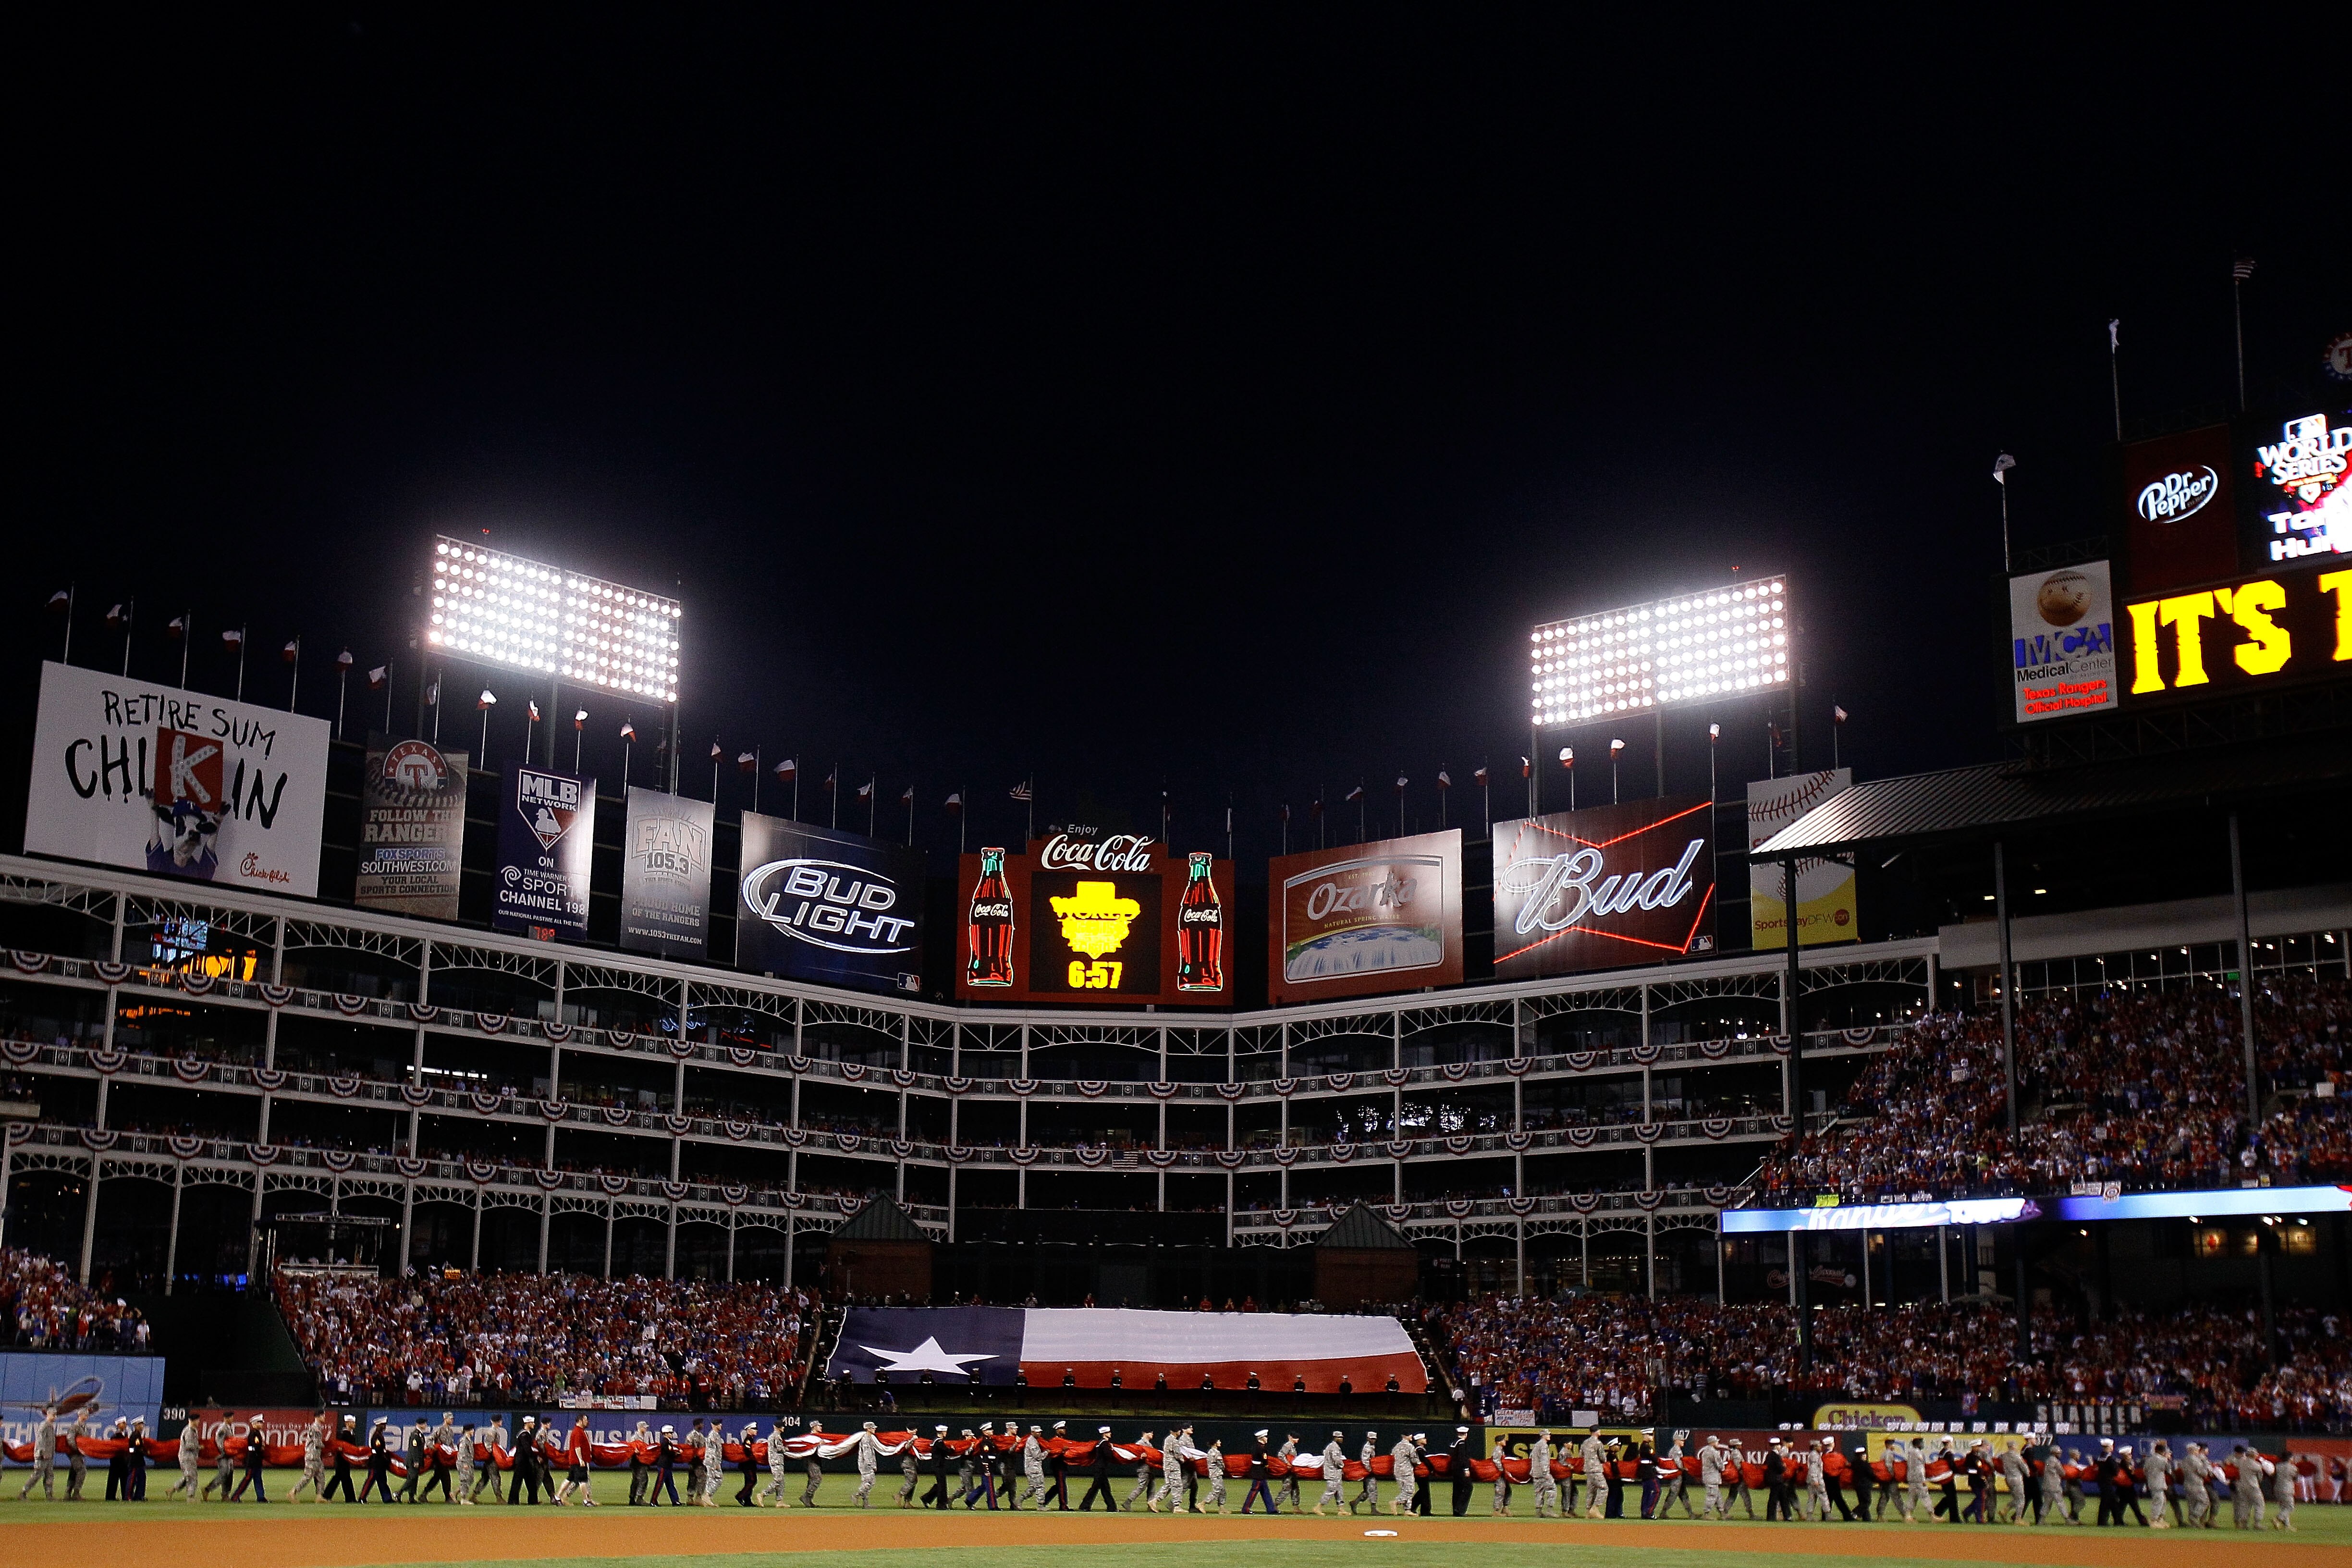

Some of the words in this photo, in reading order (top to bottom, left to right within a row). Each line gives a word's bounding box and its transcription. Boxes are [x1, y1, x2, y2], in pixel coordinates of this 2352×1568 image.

[2256, 427, 2352, 467] WORLD
[2271, 453, 2347, 485] SERIES
[2165, 472, 2193, 497] Dr
[2139, 476, 2212, 521] Pepper
[2015, 623, 2112, 668] MCA
[2127, 580, 2291, 695] IT'S
[2023, 687, 2056, 700] Texas
[2058, 679, 2107, 695] Rangers
[2025, 700, 2063, 714] Official
[2065, 692, 2107, 709] Hospital
[101, 690, 201, 731] RETIRE
[211, 708, 276, 760] SUM
[392, 745, 437, 763] TEXAS
[65, 734, 287, 829] CHIKIN
[523, 774, 577, 803] MLB
[522, 795, 577, 811] NETWORK
[370, 809, 428, 822] FOLLOW
[433, 809, 456, 822] TH
[636, 818, 703, 865] FAN
[1067, 824, 1098, 836] Enjoy
[539, 857, 554, 868] ON
[647, 852, 689, 876] 105.3
[1041, 834, 1156, 872] Coca-Cola
[361, 860, 456, 873] SOUTHWEST.COM
[523, 868, 539, 877] TIME
[540, 871, 567, 882] WARNER
[360, 886, 396, 894] SPORTS
[381, 876, 407, 885] YOUR
[410, 875, 439, 884] LOCAL
[523, 878, 582, 897] SPORT
[784, 866, 895, 910] BUD
[1501, 839, 1705, 934] Bud
[500, 890, 562, 911] CHANNEL
[565, 902, 585, 915] 198
[1307, 870, 1418, 920] Ozarka
[510, 911, 532, 920] NATIONAL
[632, 907, 641, 918] OF
[645, 910, 660, 921] THE
[662, 913, 700, 927] RANGERS
[671, 902, 700, 917] HOME
[761, 892, 915, 943] LIGHT
[1324, 919, 1351, 929] NATURAL
[1354, 915, 1377, 923] SPRING
[1068, 961, 1123, 989] 6:57
[1828, 1410, 1907, 1427] Chicken
